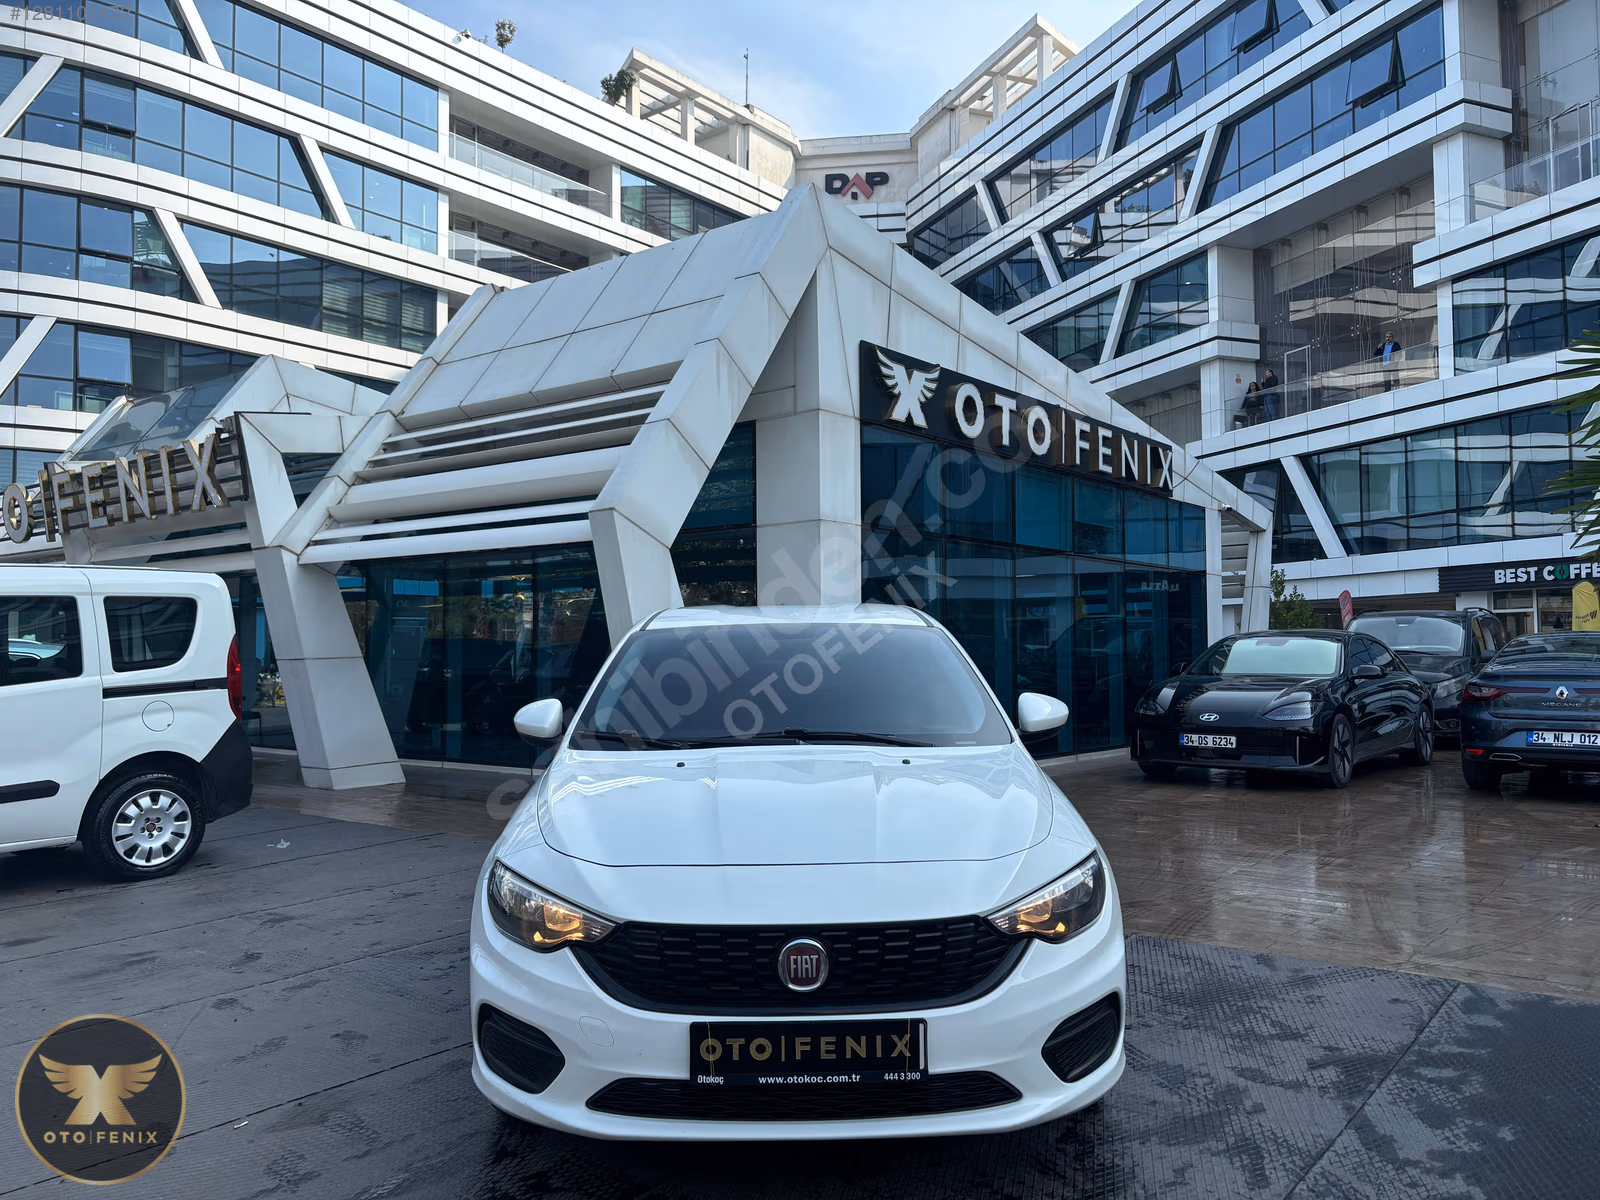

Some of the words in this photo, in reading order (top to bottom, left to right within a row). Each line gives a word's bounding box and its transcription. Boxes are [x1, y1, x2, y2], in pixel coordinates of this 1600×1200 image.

[825, 171, 889, 200] DAP
[1494, 567, 1537, 584] BEST
[1184, 735, 1194, 745] 34
[1198, 736, 1208, 746] DS
[1212, 737, 1233, 747] 6234
[1533, 732, 1546, 742] 34
[1553, 733, 1574, 743] NLJ
[1580, 734, 1598, 745] 012
[790, 955, 818, 978] FIAT
[758, 1074, 861, 1084] www.otokoc.com.tr
